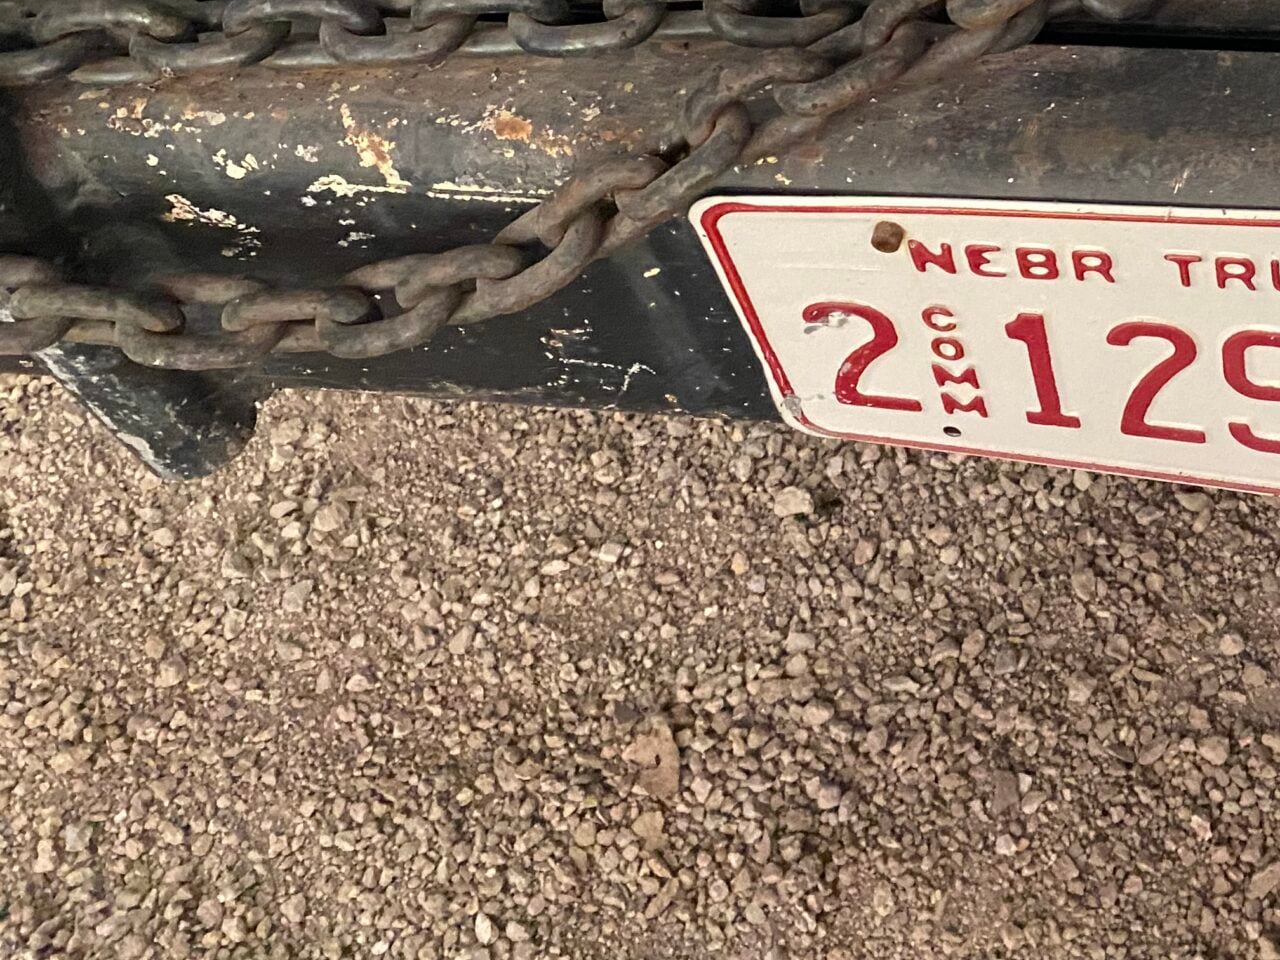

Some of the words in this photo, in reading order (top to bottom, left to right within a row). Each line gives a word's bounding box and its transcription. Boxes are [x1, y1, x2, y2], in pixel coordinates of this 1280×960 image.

[907, 239, 1116, 284] NEBR
[801, 300, 923, 412] 2
[921, 305, 990, 419] COMM
